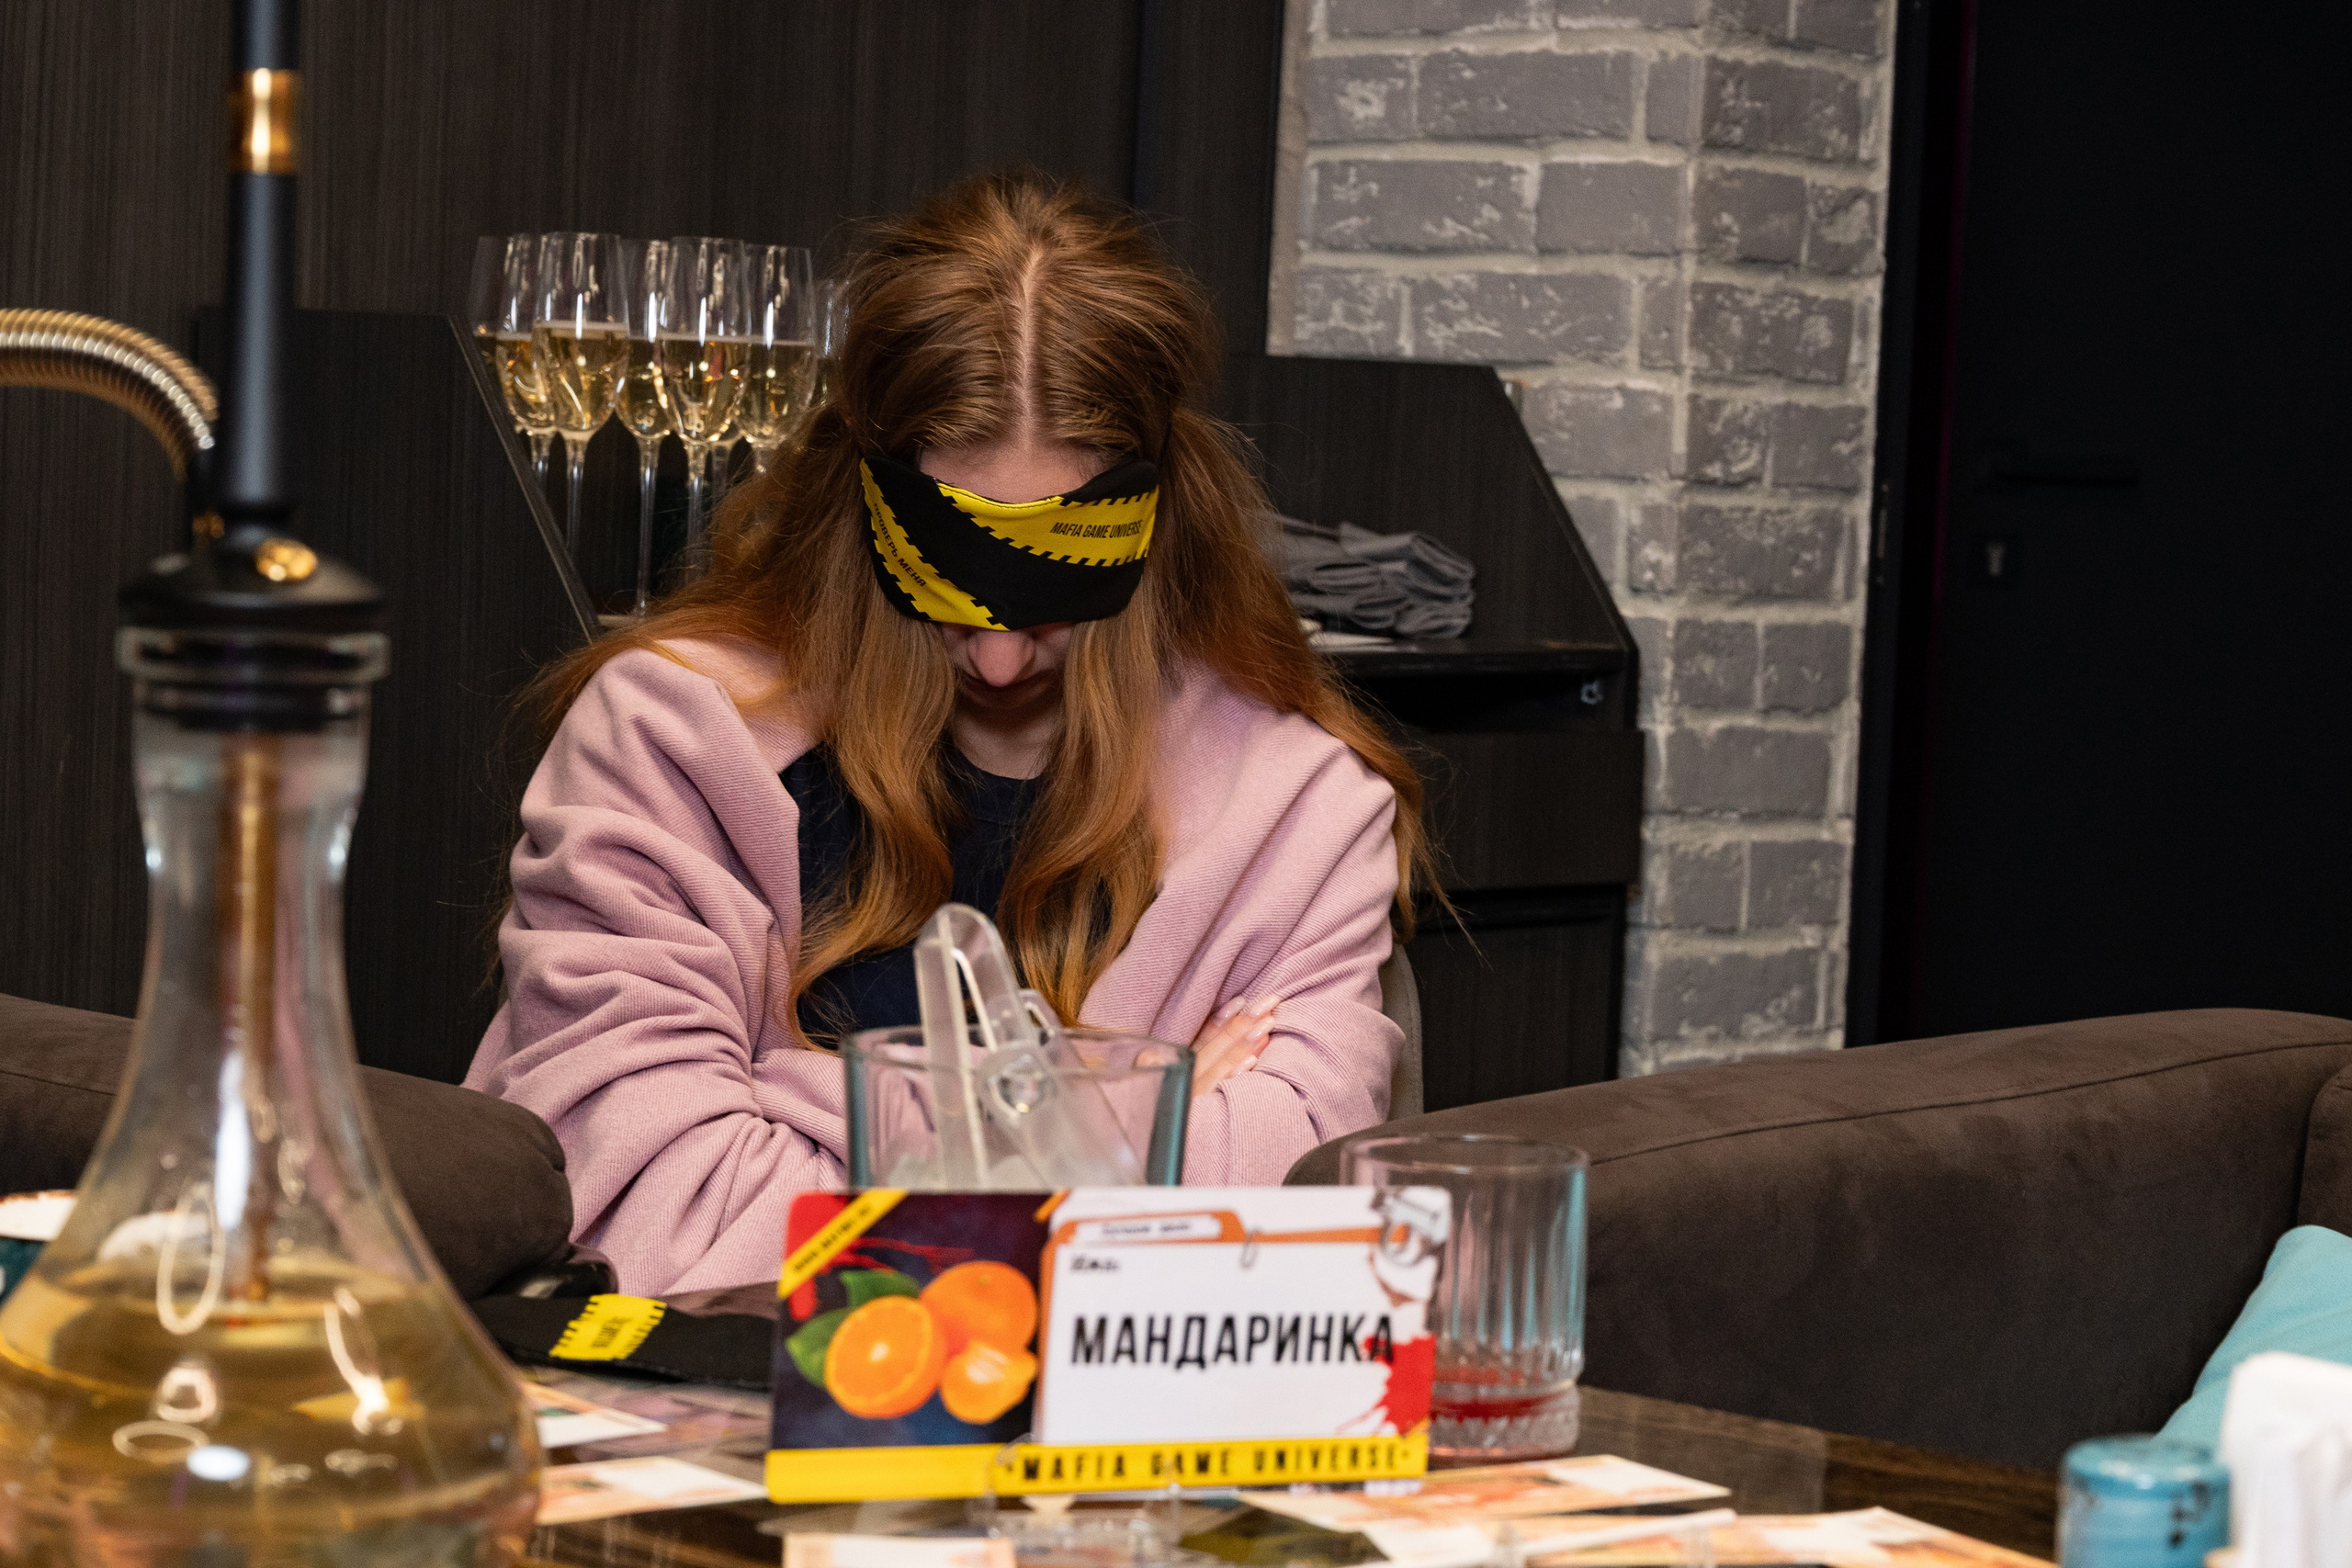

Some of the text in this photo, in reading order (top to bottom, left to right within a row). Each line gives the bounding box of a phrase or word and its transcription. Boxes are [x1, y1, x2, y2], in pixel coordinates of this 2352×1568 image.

[873, 502, 927, 587] ПРОВЕРЬ МЕНЯ
[1049, 522, 1083, 537] MAFIA
[1082, 525, 1111, 538] GAME
[1071, 1314, 1394, 1370] МАНДАРИНКА
[1022, 1441, 1396, 1482] MAFIA GAME UNIVERSE
